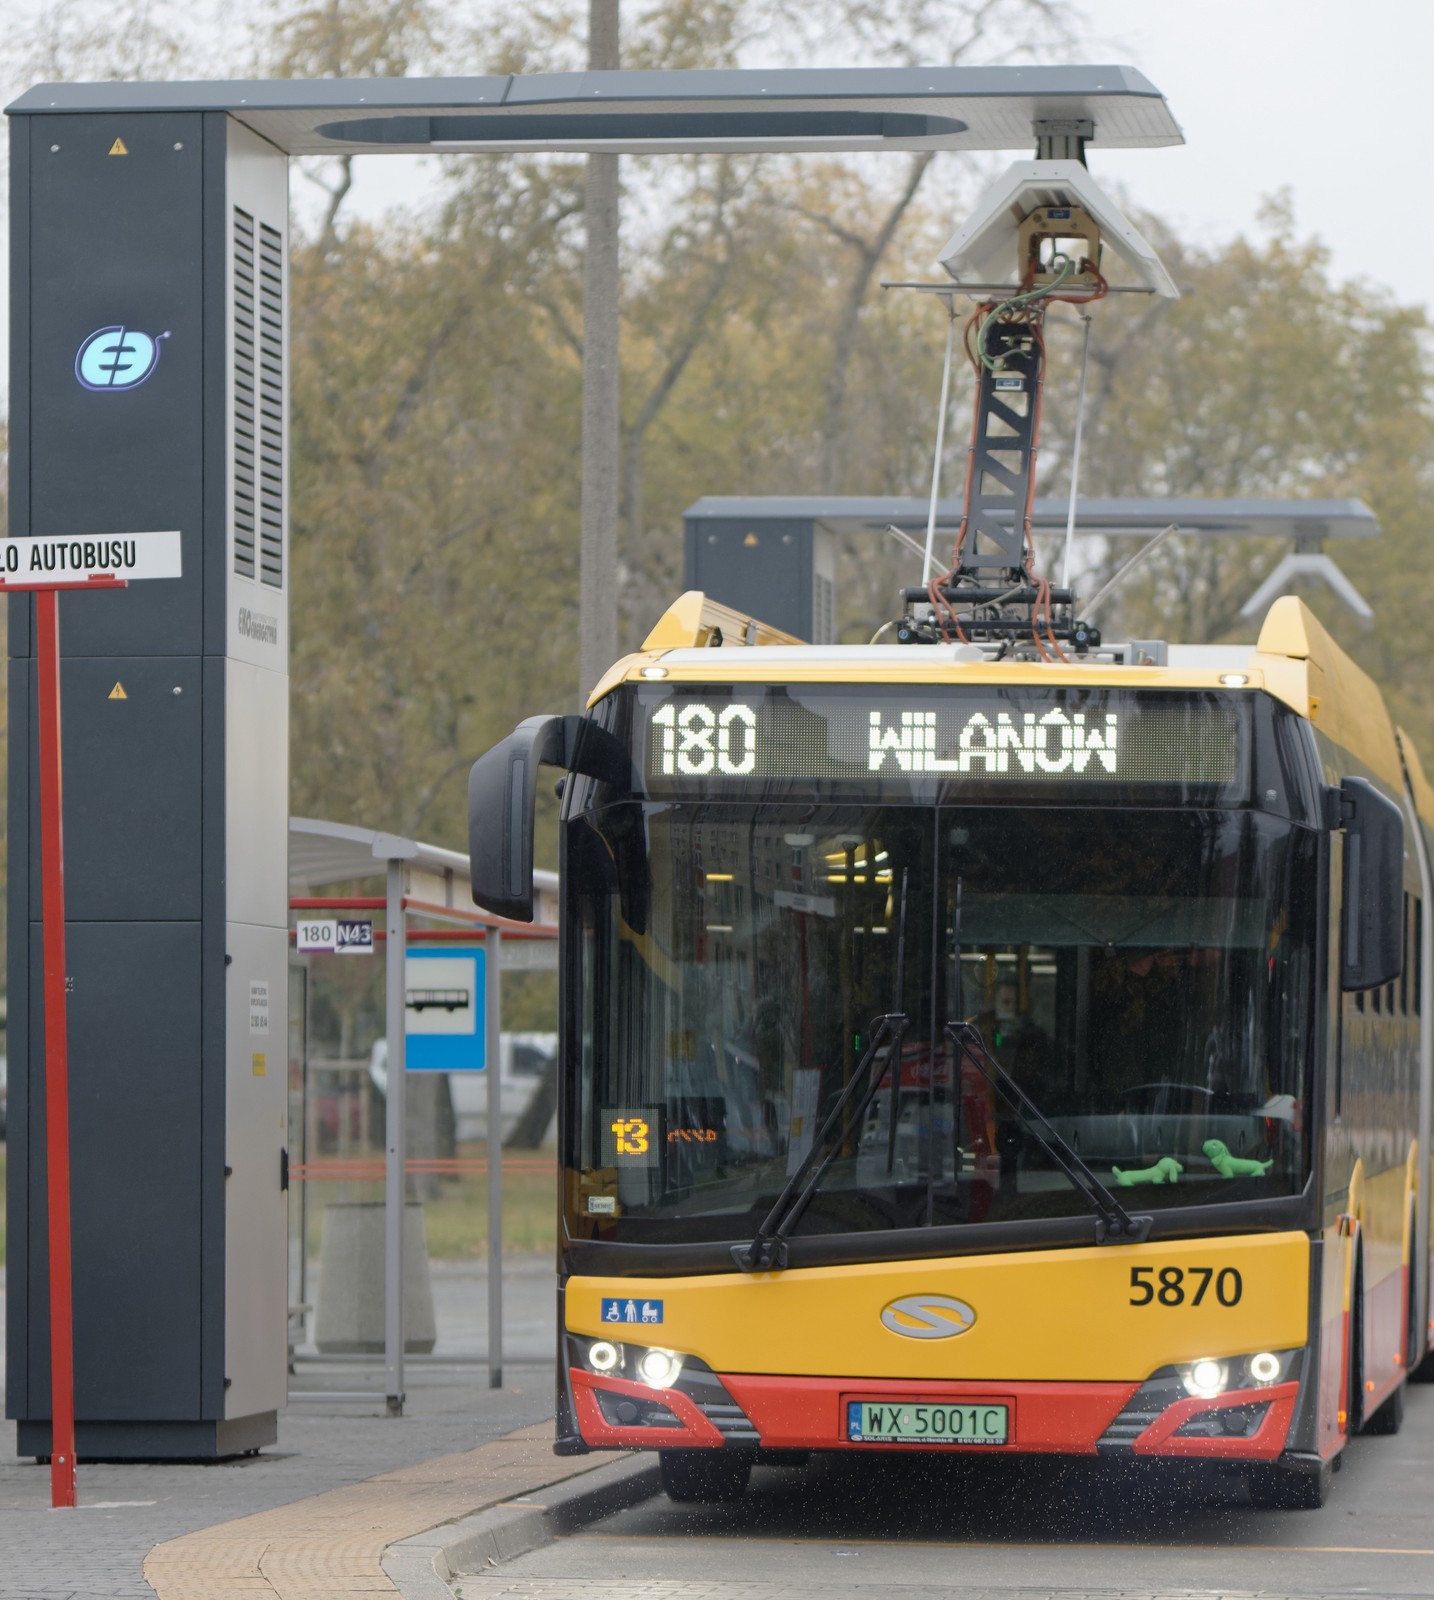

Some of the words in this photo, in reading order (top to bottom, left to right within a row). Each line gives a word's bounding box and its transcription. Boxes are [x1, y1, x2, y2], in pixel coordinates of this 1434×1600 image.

[29, 540, 136, 571] AUTOBUSU
[652, 704, 756, 775] 180
[869, 708, 1117, 773] WILANÓW
[302, 926, 331, 942] 180
[337, 924, 371, 943] N43
[611, 1118, 649, 1155] 13
[1129, 1266, 1243, 1307] 5870
[850, 1422, 861, 1430] PL
[868, 1407, 902, 1434] WX
[915, 1408, 999, 1436] 5001C
